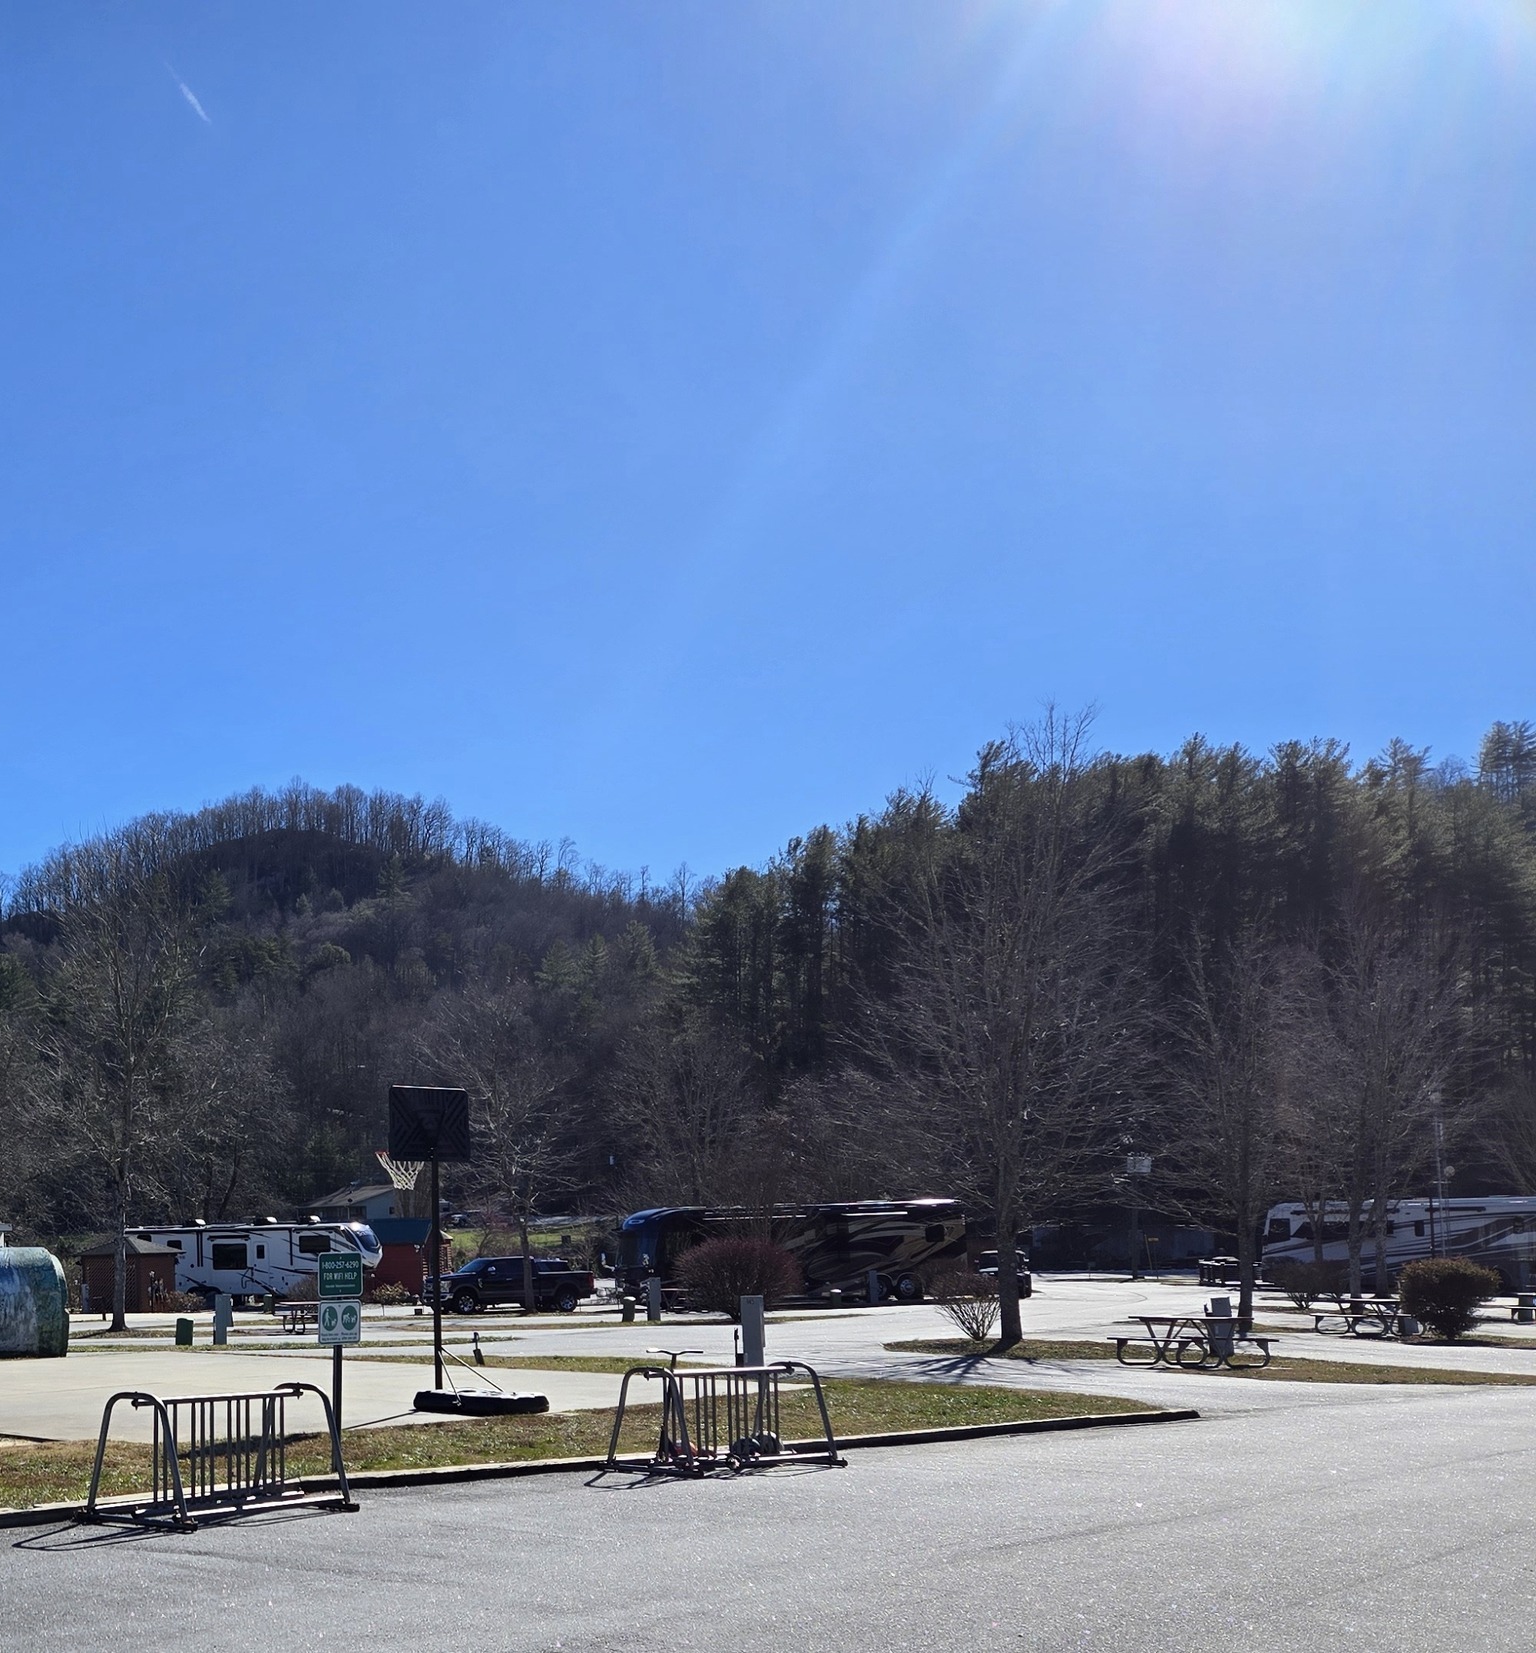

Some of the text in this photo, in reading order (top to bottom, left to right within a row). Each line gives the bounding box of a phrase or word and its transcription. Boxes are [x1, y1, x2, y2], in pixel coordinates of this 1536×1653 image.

[321, 1261, 359, 1269] 1-800-257-6290
[323, 1272, 333, 1281] FOR
[345, 1272, 357, 1280] HELP
